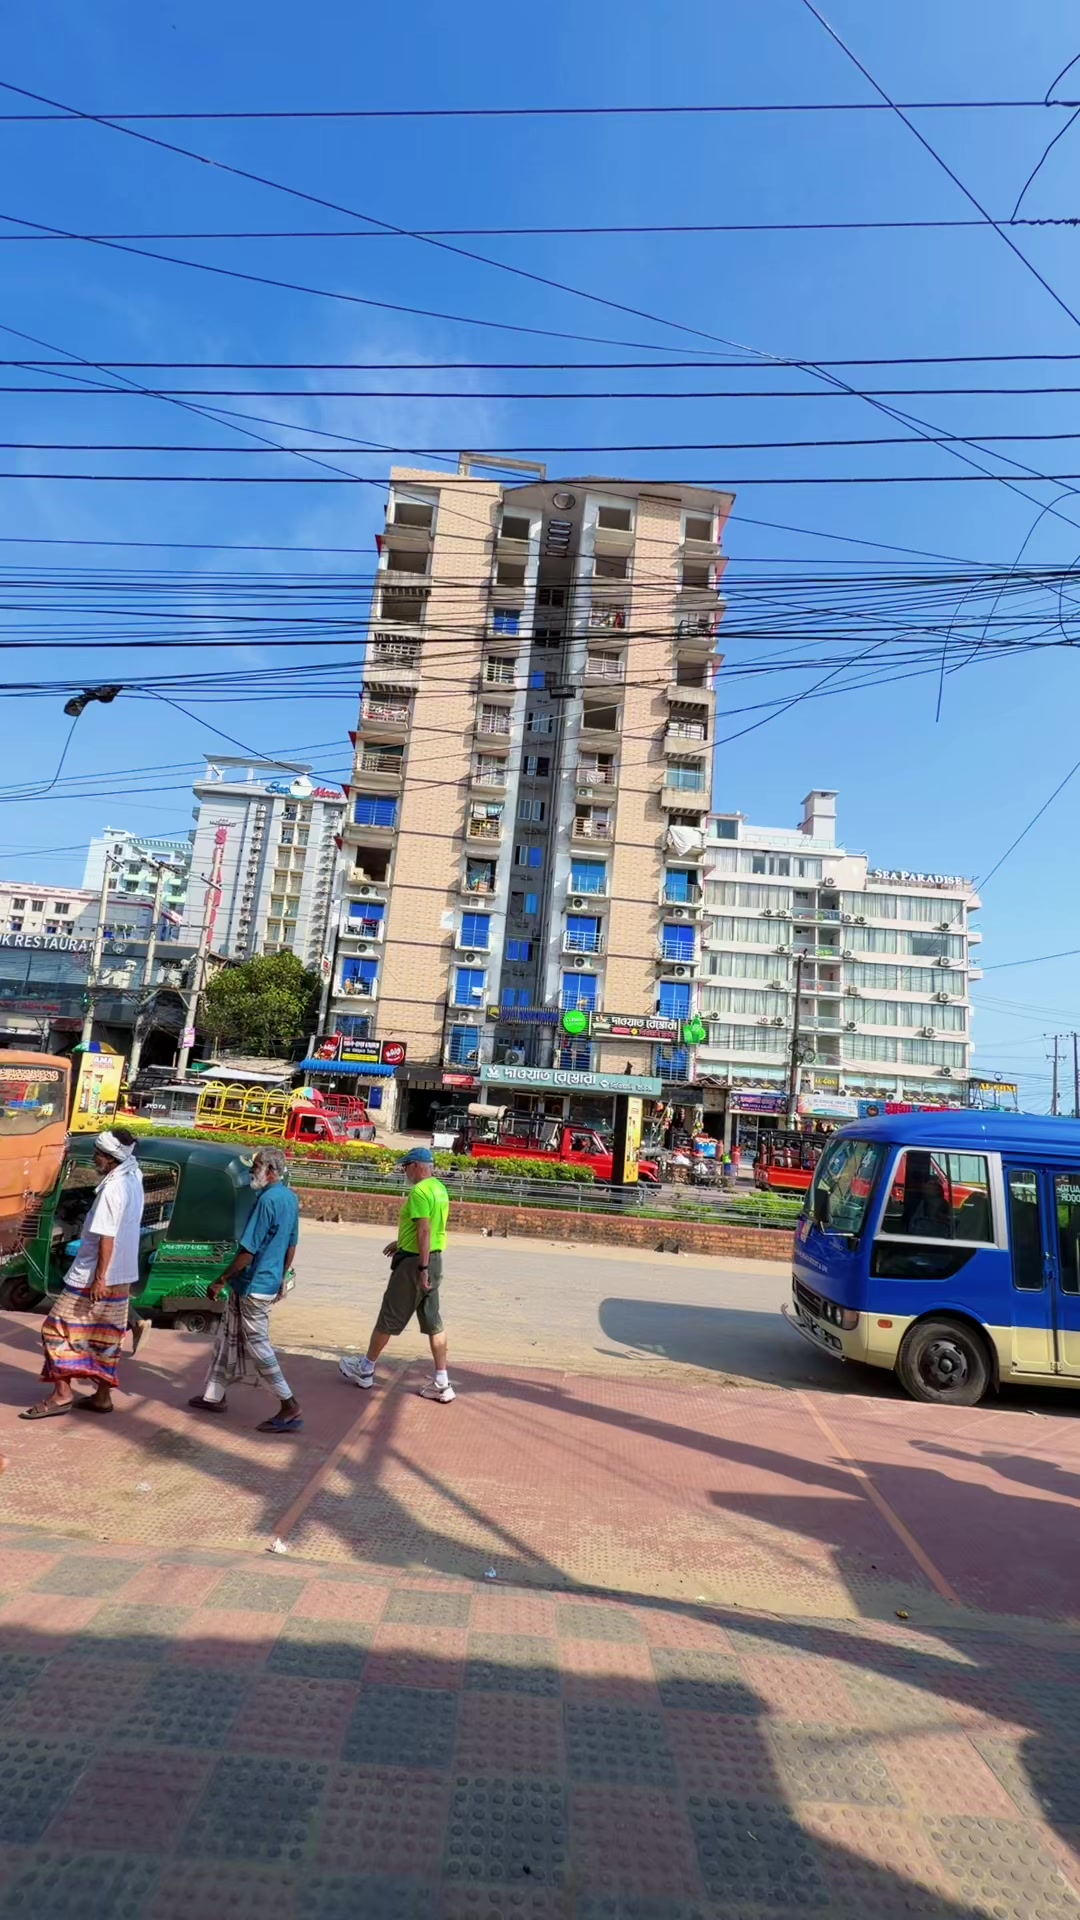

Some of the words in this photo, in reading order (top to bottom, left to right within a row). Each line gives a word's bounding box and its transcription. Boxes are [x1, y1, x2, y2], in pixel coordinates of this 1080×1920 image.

[874, 868, 899, 880] SEA
[900, 870, 963, 886] PARADISE
[0, 933, 12, 946] K
[504, 1067, 550, 1082] দাওয়াত
